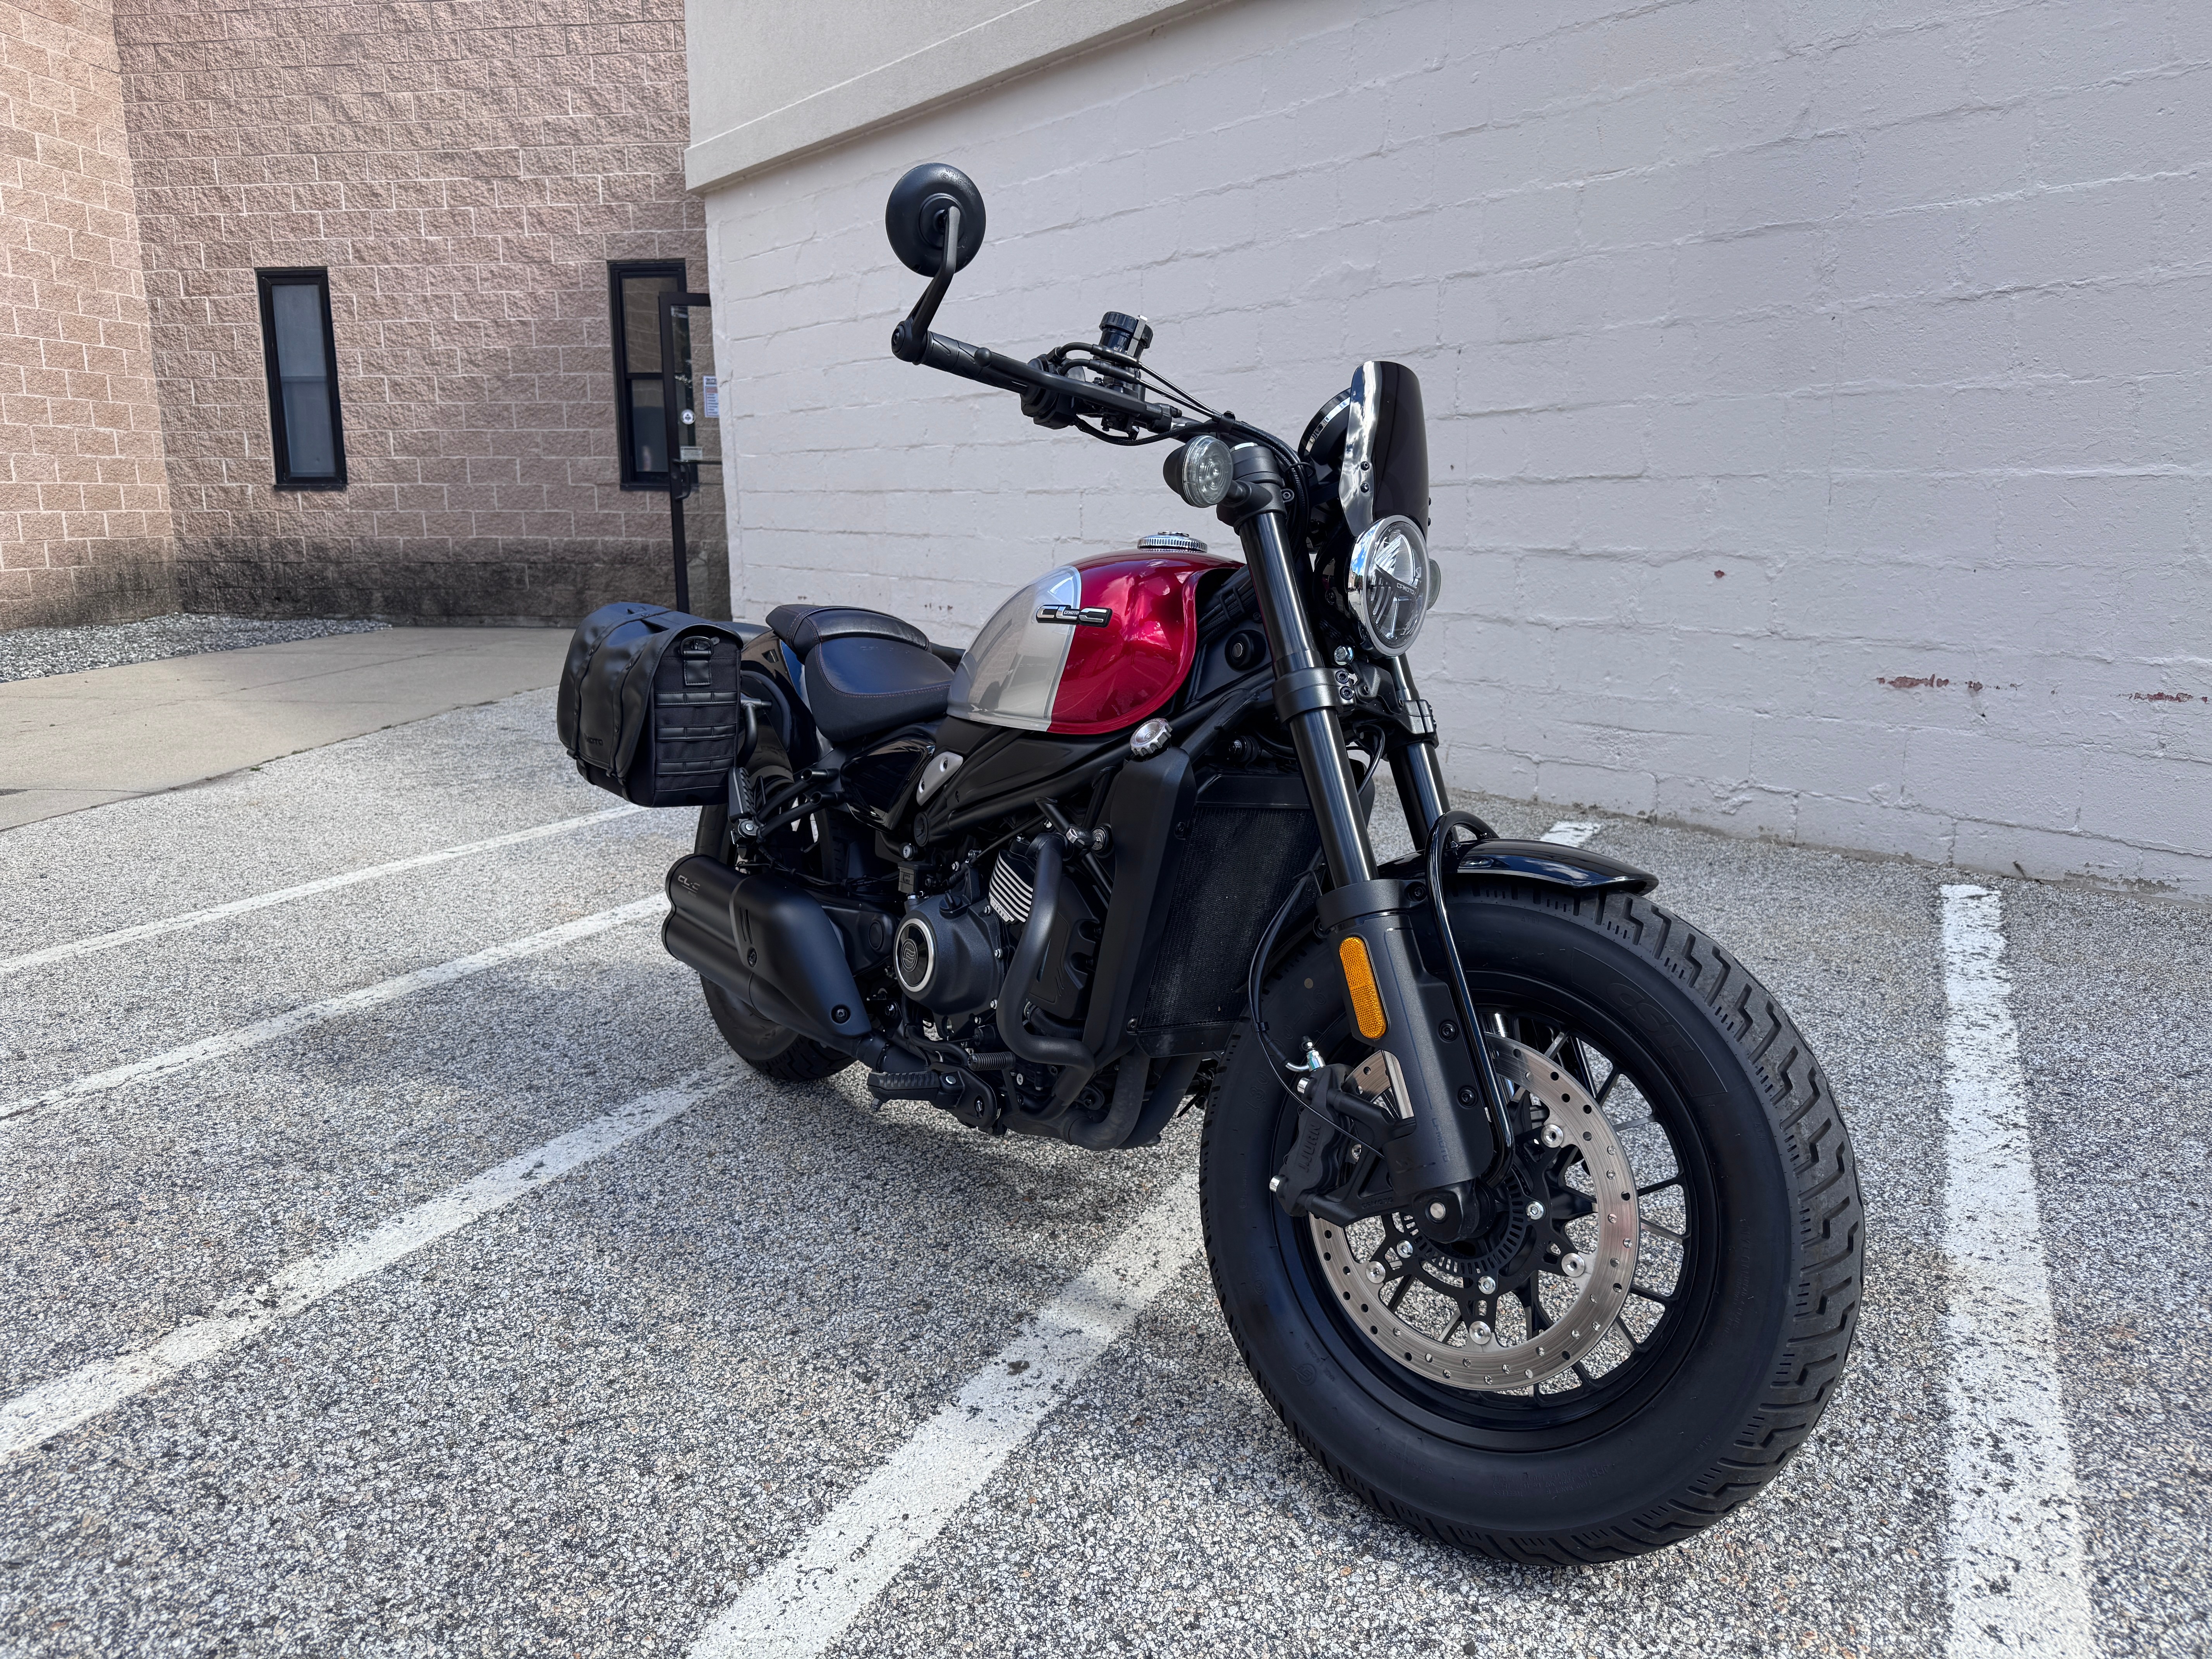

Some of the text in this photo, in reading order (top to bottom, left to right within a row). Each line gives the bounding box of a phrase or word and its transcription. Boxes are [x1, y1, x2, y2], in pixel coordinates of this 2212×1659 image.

[1396, 582, 1414, 595] CFMOTO
[1606, 982, 1694, 1059] CST
[1299, 1124, 1321, 1173] J.JUAN
